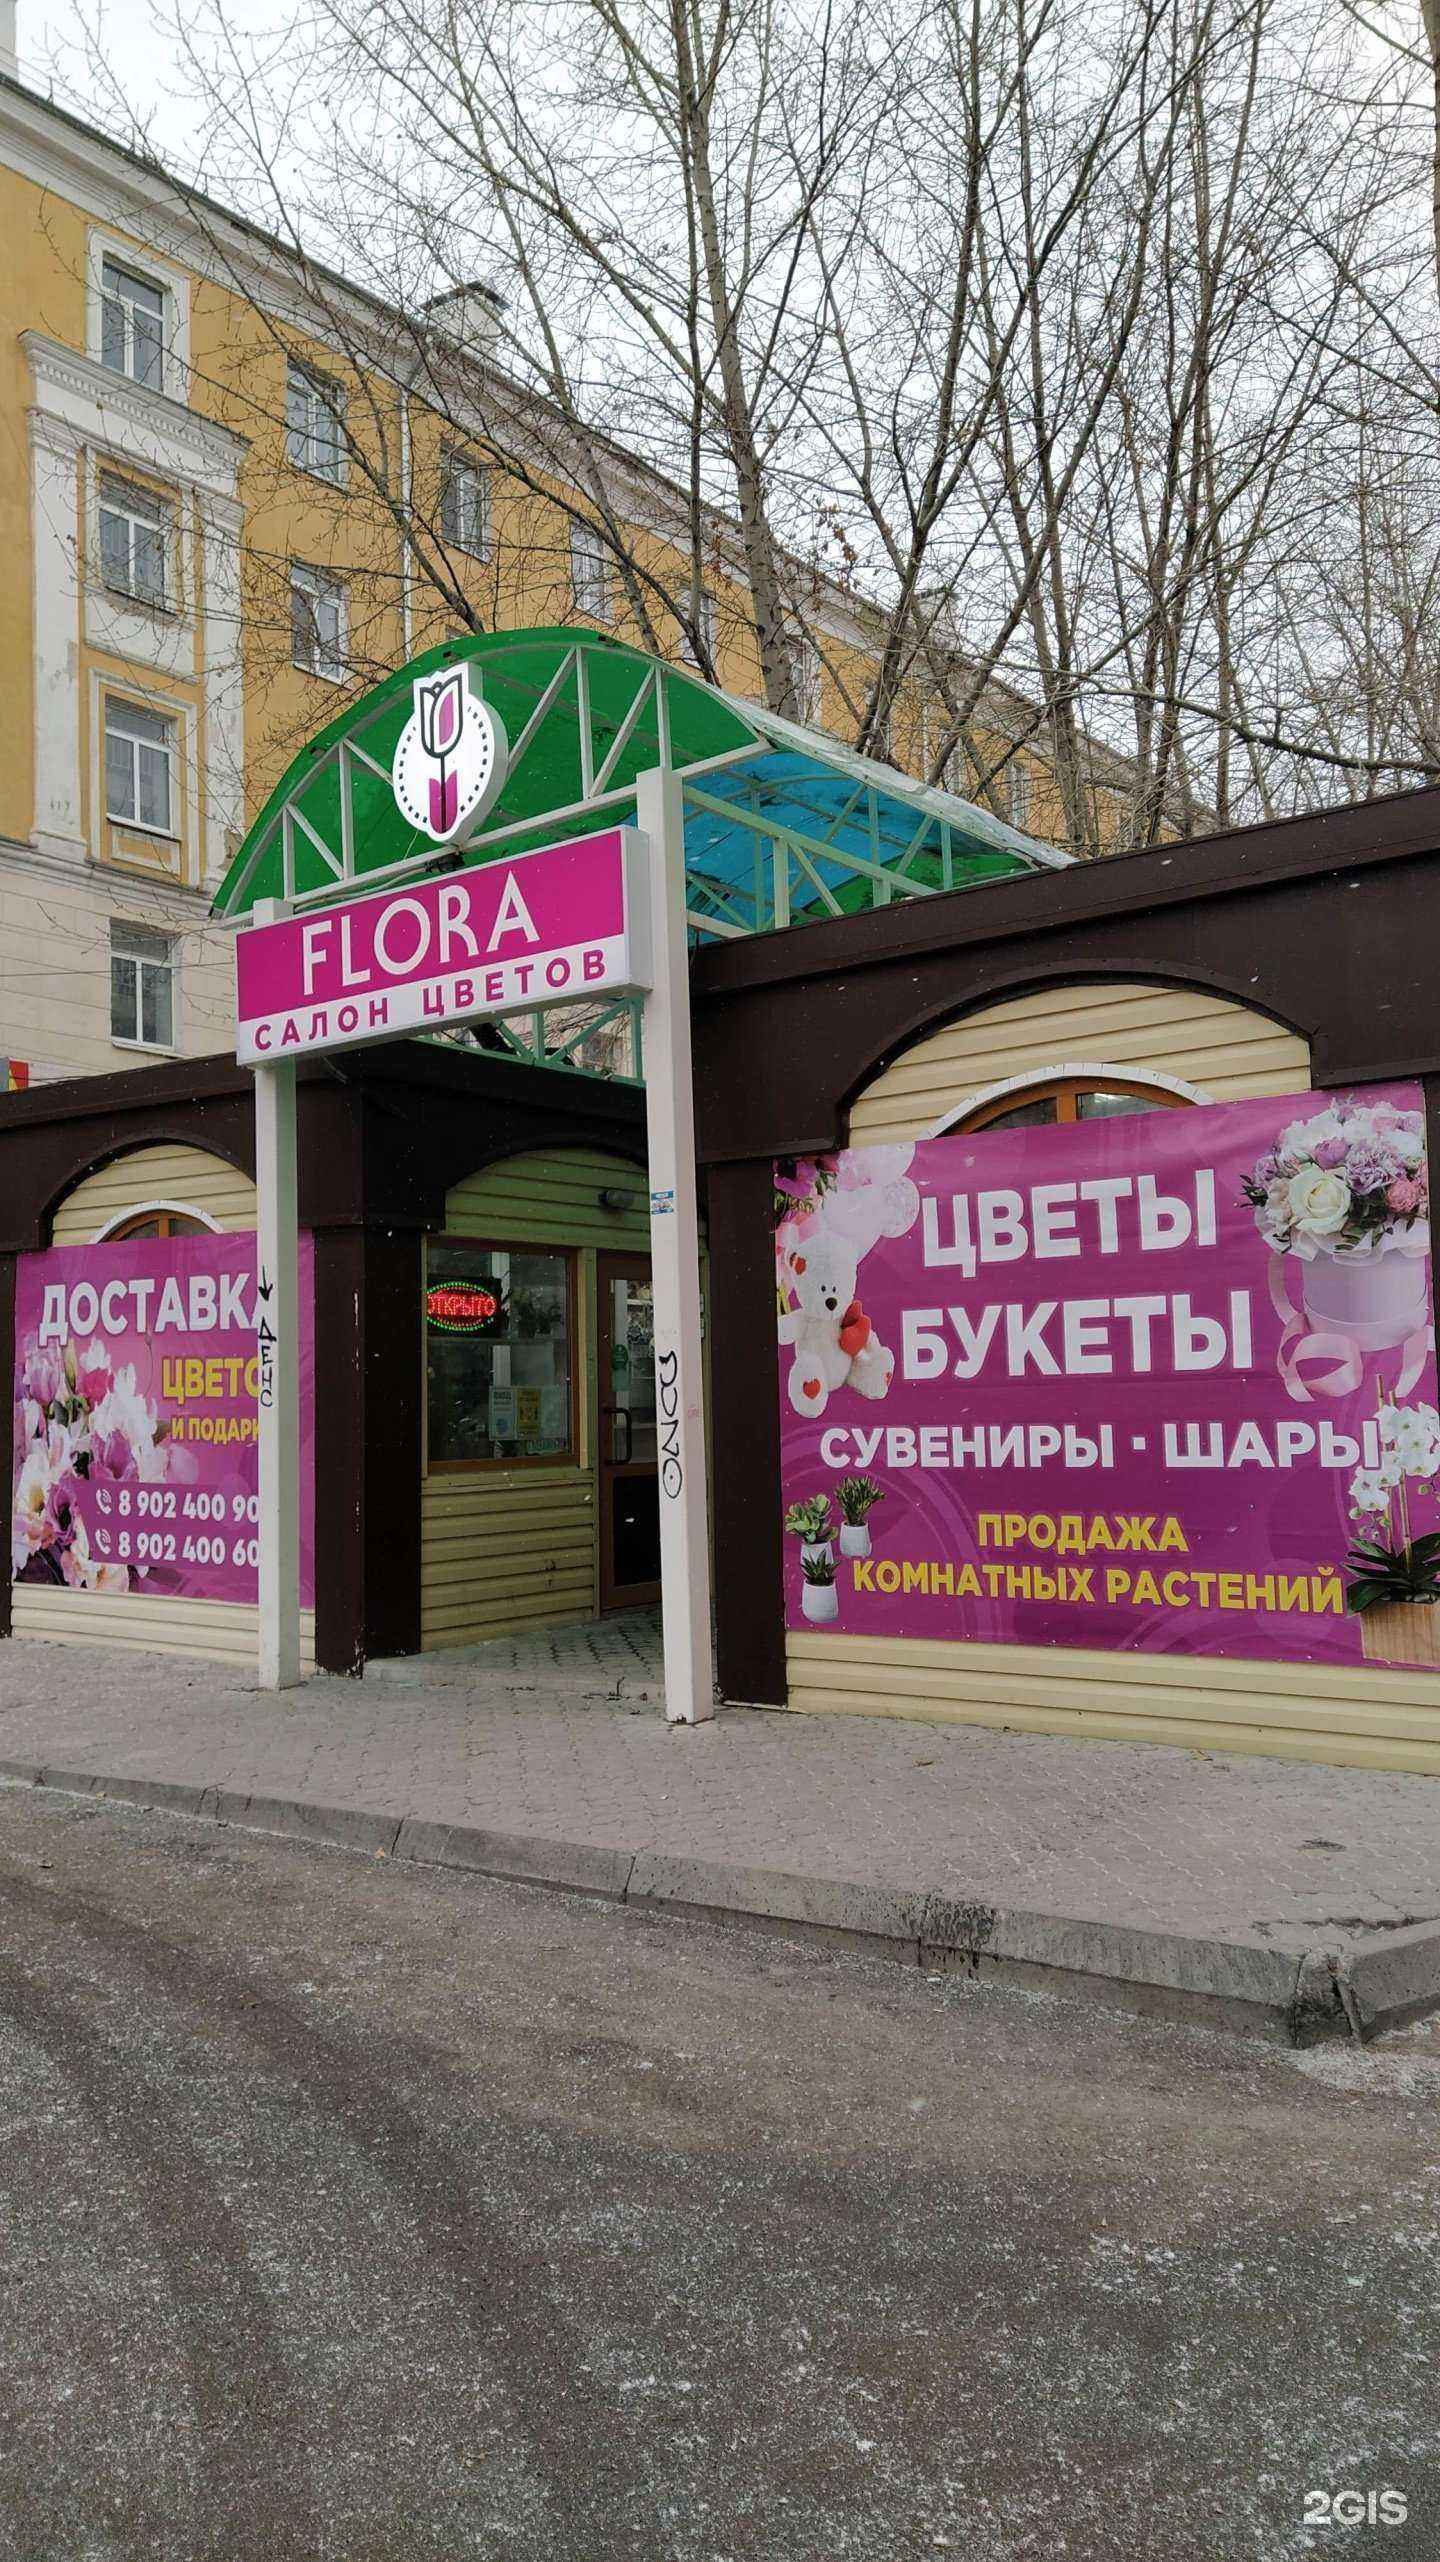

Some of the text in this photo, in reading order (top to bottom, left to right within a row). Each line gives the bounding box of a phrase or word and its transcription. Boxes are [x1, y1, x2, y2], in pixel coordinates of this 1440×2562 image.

[302, 870, 540, 995] FLORA
[255, 949, 607, 1050] САЛОН ЦВЕТОВ
[921, 1169, 1217, 1277] ЦВЕТЫ
[39, 1273, 259, 1347] ДОСТАВК
[902, 1291, 1253, 1379] БУКЕТЫ
[172, 1418, 184, 1440] И
[820, 1420, 1380, 1468] СУВЕНИРЫ ШАРЫ
[118, 1489, 259, 1523] 8 902 400 90
[118, 1531, 259, 1568] 8 902 400 60
[978, 1513, 1189, 1555] ПРОДАЖА
[853, 1560, 1344, 1613] КОМНАТНЫХ РАСТЕНИЙ
